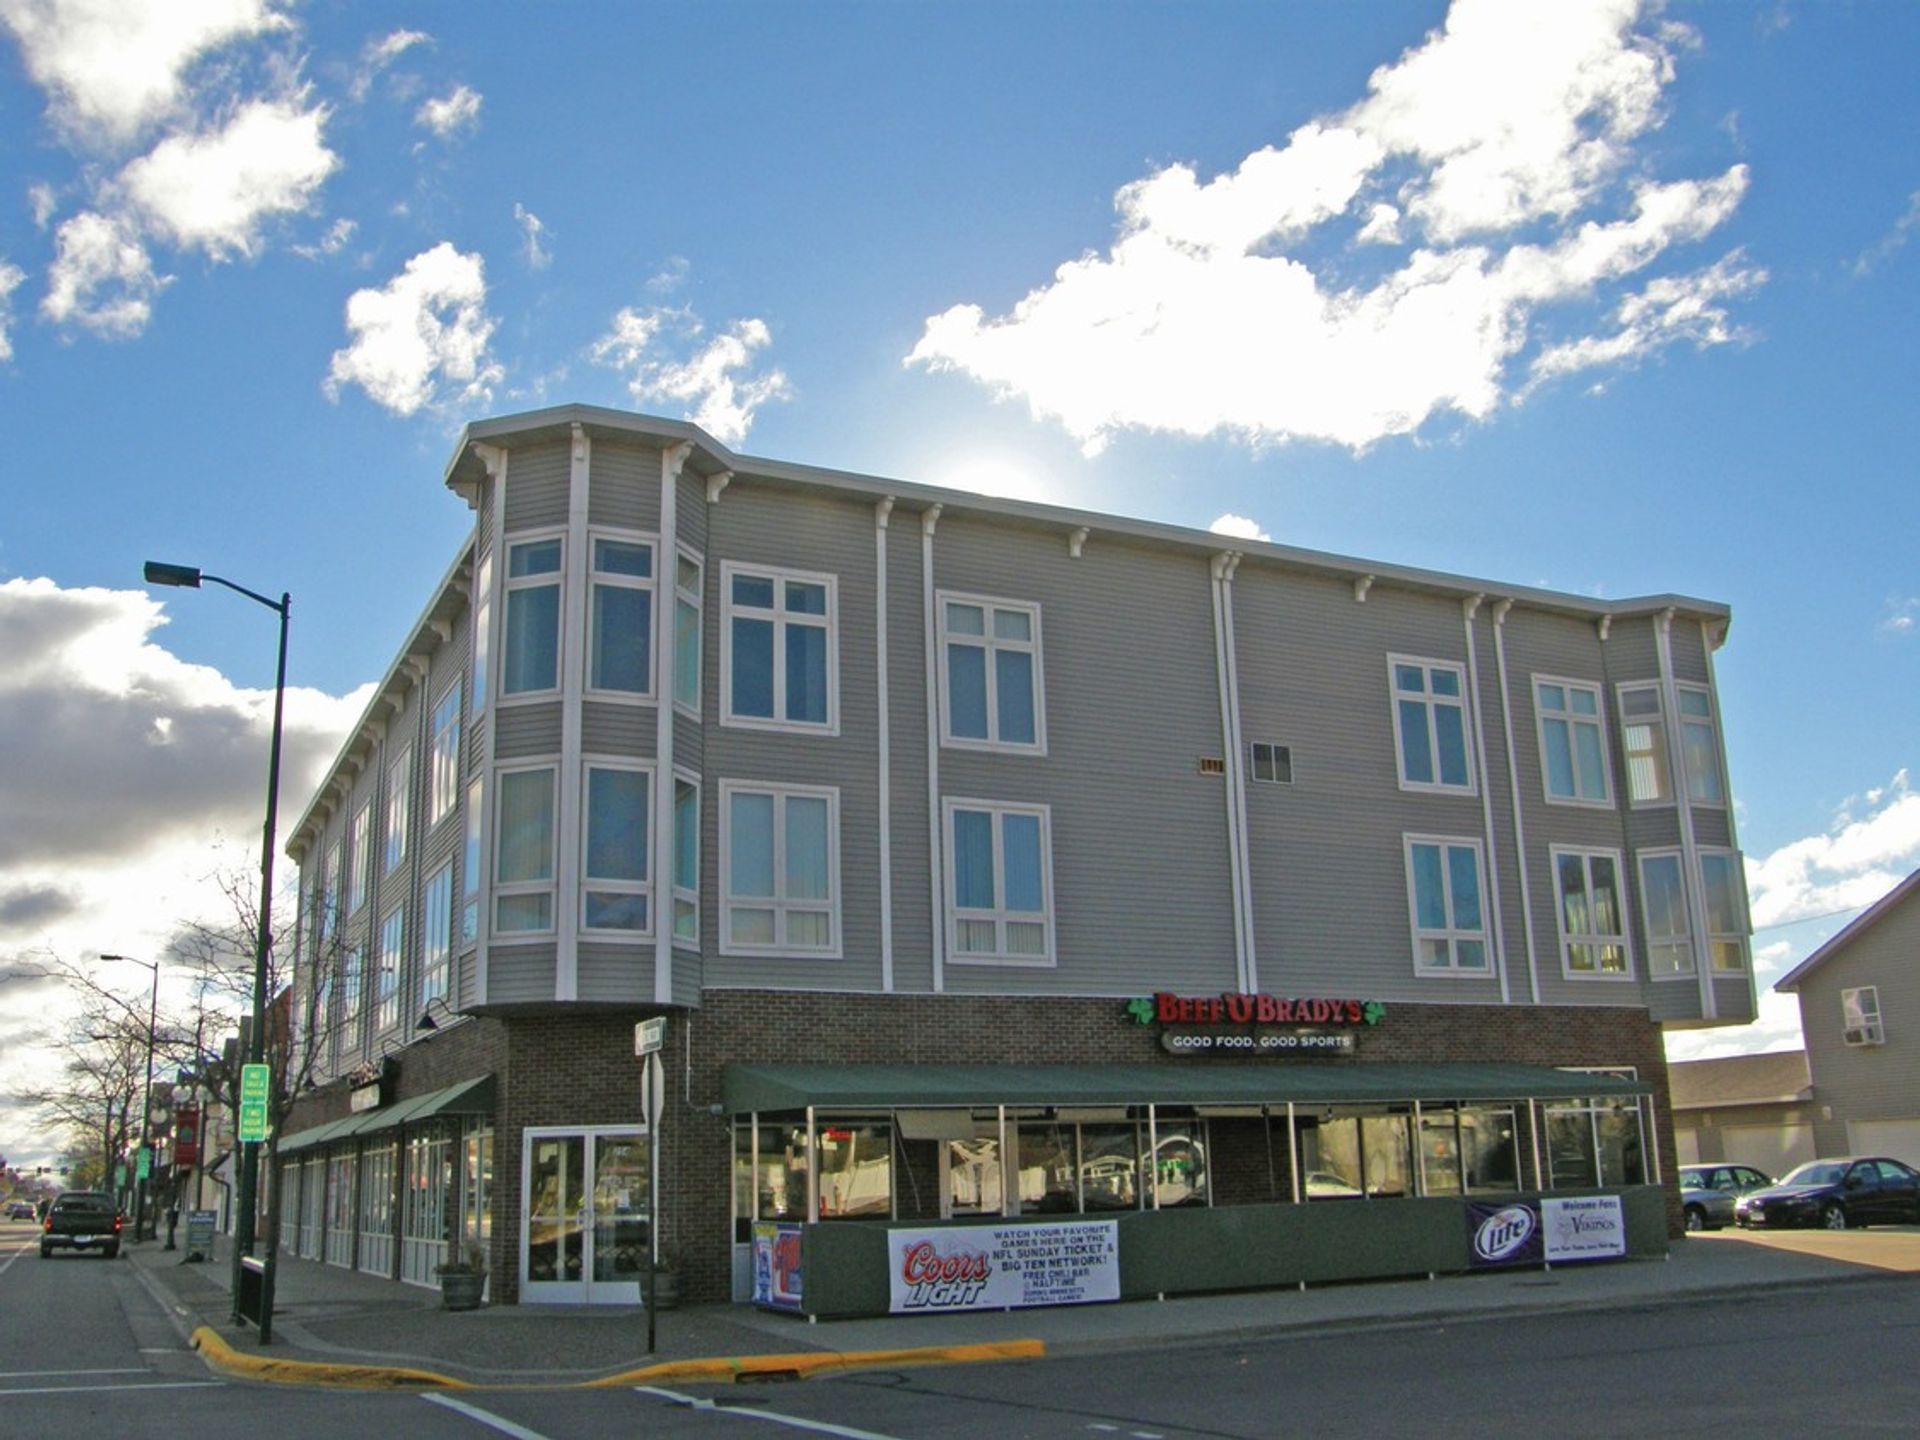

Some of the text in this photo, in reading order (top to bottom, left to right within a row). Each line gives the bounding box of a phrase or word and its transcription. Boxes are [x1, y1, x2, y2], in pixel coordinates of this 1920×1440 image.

[1156, 993, 1225, 1022] BEEF
[1256, 993, 1361, 1022] BRADY'S
[1172, 1035, 1212, 1047] GOOD
[1260, 1035, 1298, 1047] GOOD
[1300, 1035, 1351, 1047] SPORTS
[1562, 1201, 1596, 1210] Welcome
[994, 1225, 1110, 1239] WATCH YOUR FAVORITE
[1002, 1234, 1105, 1248] GAMES HERE ON THE
[993, 1243, 1114, 1260] NFL SUNDAY TICKET &
[903, 1240, 993, 1285] Coors
[1001, 1255, 1107, 1272] BIG TEN NETWORK!
[1023, 1271, 1045, 1280] FREE
[1072, 1268, 1089, 1276] BAR
[904, 1281, 987, 1308] LIGHT
